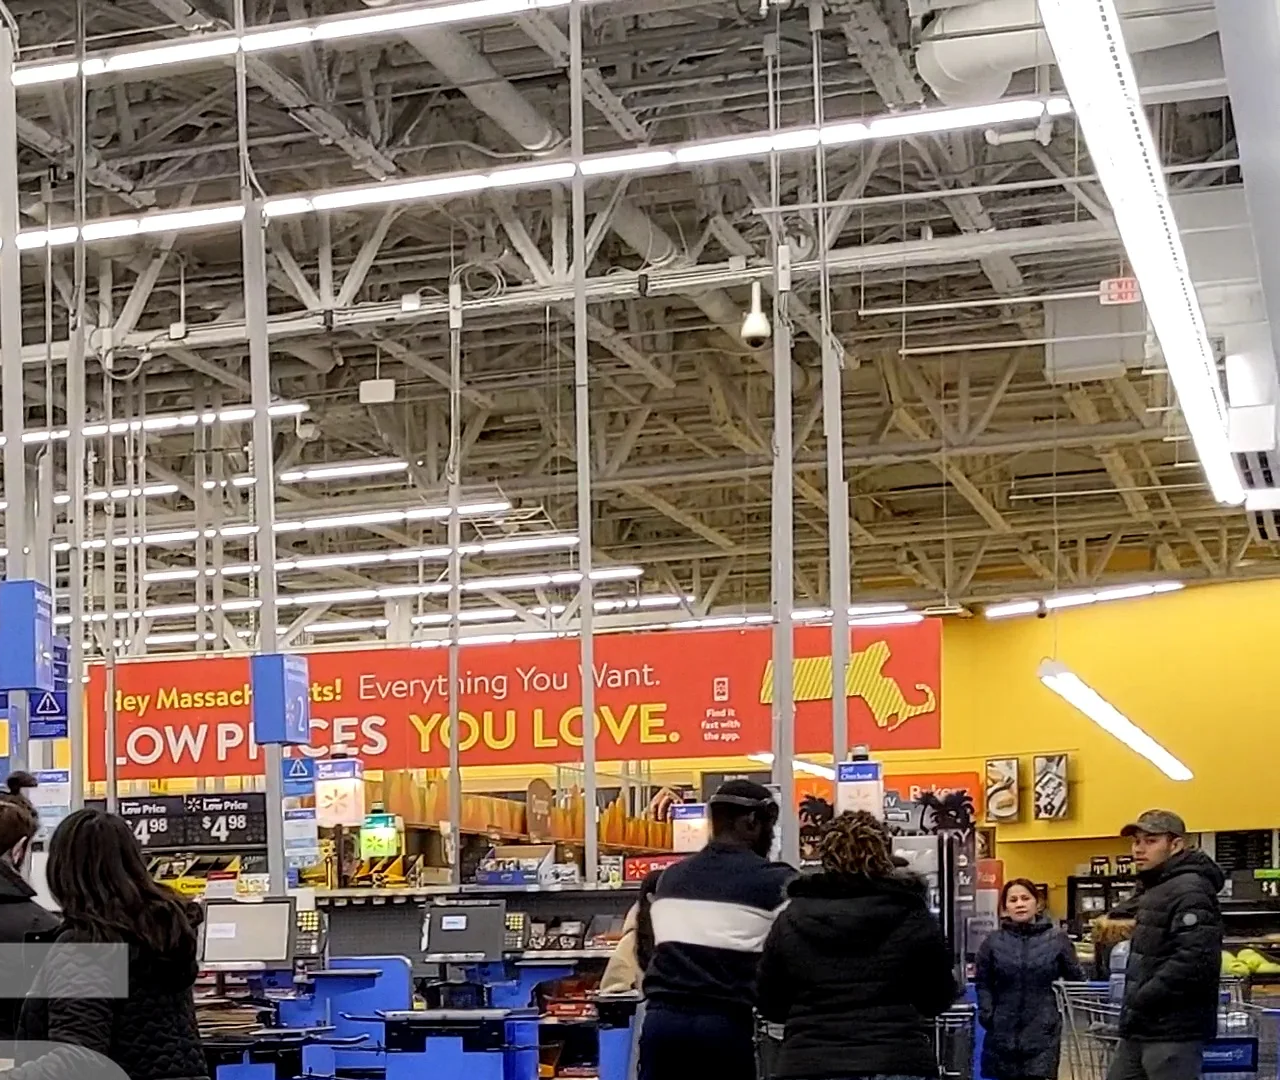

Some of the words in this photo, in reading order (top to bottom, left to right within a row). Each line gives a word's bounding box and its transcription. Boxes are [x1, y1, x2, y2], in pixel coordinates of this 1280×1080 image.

[516, 667, 569, 693] You
[297, 696, 305, 732] 2
[706, 708, 727, 718] Find
[701, 720, 719, 729] fast
[720, 720, 741, 729] with
[105, 724, 208, 766] OW
[216, 714, 388, 762] PCES
[408, 709, 516, 754] YOU
[534, 702, 681, 749] LOVE.
[703, 732, 719, 741] the
[720, 732, 740, 742] app.
[122, 803, 141, 815] Low
[142, 804, 167, 814] Price
[202, 801, 223, 812] Low
[224, 800, 248, 811] Price
